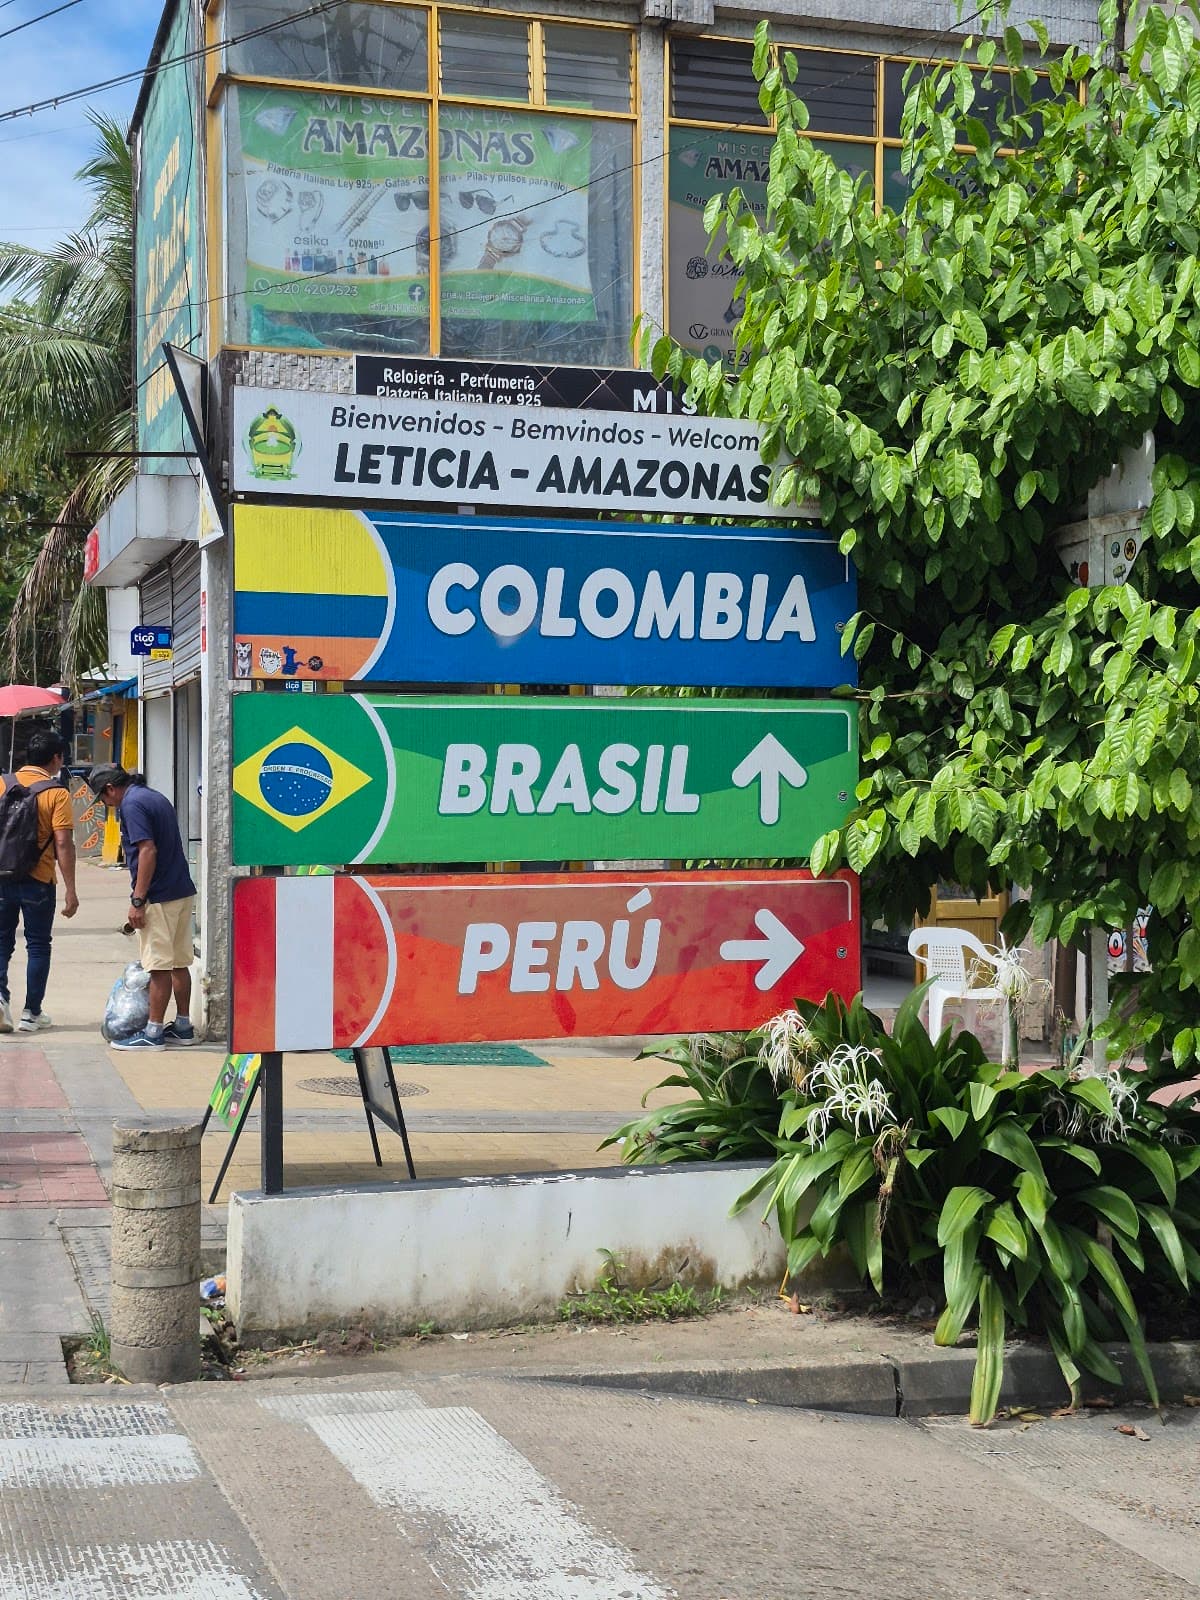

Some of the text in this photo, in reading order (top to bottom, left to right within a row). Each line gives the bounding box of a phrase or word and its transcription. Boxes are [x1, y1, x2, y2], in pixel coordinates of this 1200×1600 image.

[302, 117, 535, 167] AMAZONAS
[717, 142, 769, 156] MISCE
[337, 179, 354, 190] Ley
[705, 156, 770, 182] AMAZ
[710, 327, 734, 337] GIOVA
[376, 385, 429, 399] Platería
[434, 388, 483, 403] Italiana
[516, 393, 542, 407] 925
[383, 367, 445, 386] Relojería
[460, 372, 535, 391] Perfumería
[330, 405, 486, 437] Bienvenidos
[510, 418, 644, 446] Bemvindos
[668, 427, 759, 452] Welcom
[333, 442, 500, 491] LETICIA
[535, 454, 773, 504] AMAZONAS
[427, 562, 817, 641] COLOMBIA
[439, 743, 700, 814] BRASIL
[458, 888, 662, 994] PERÚ
